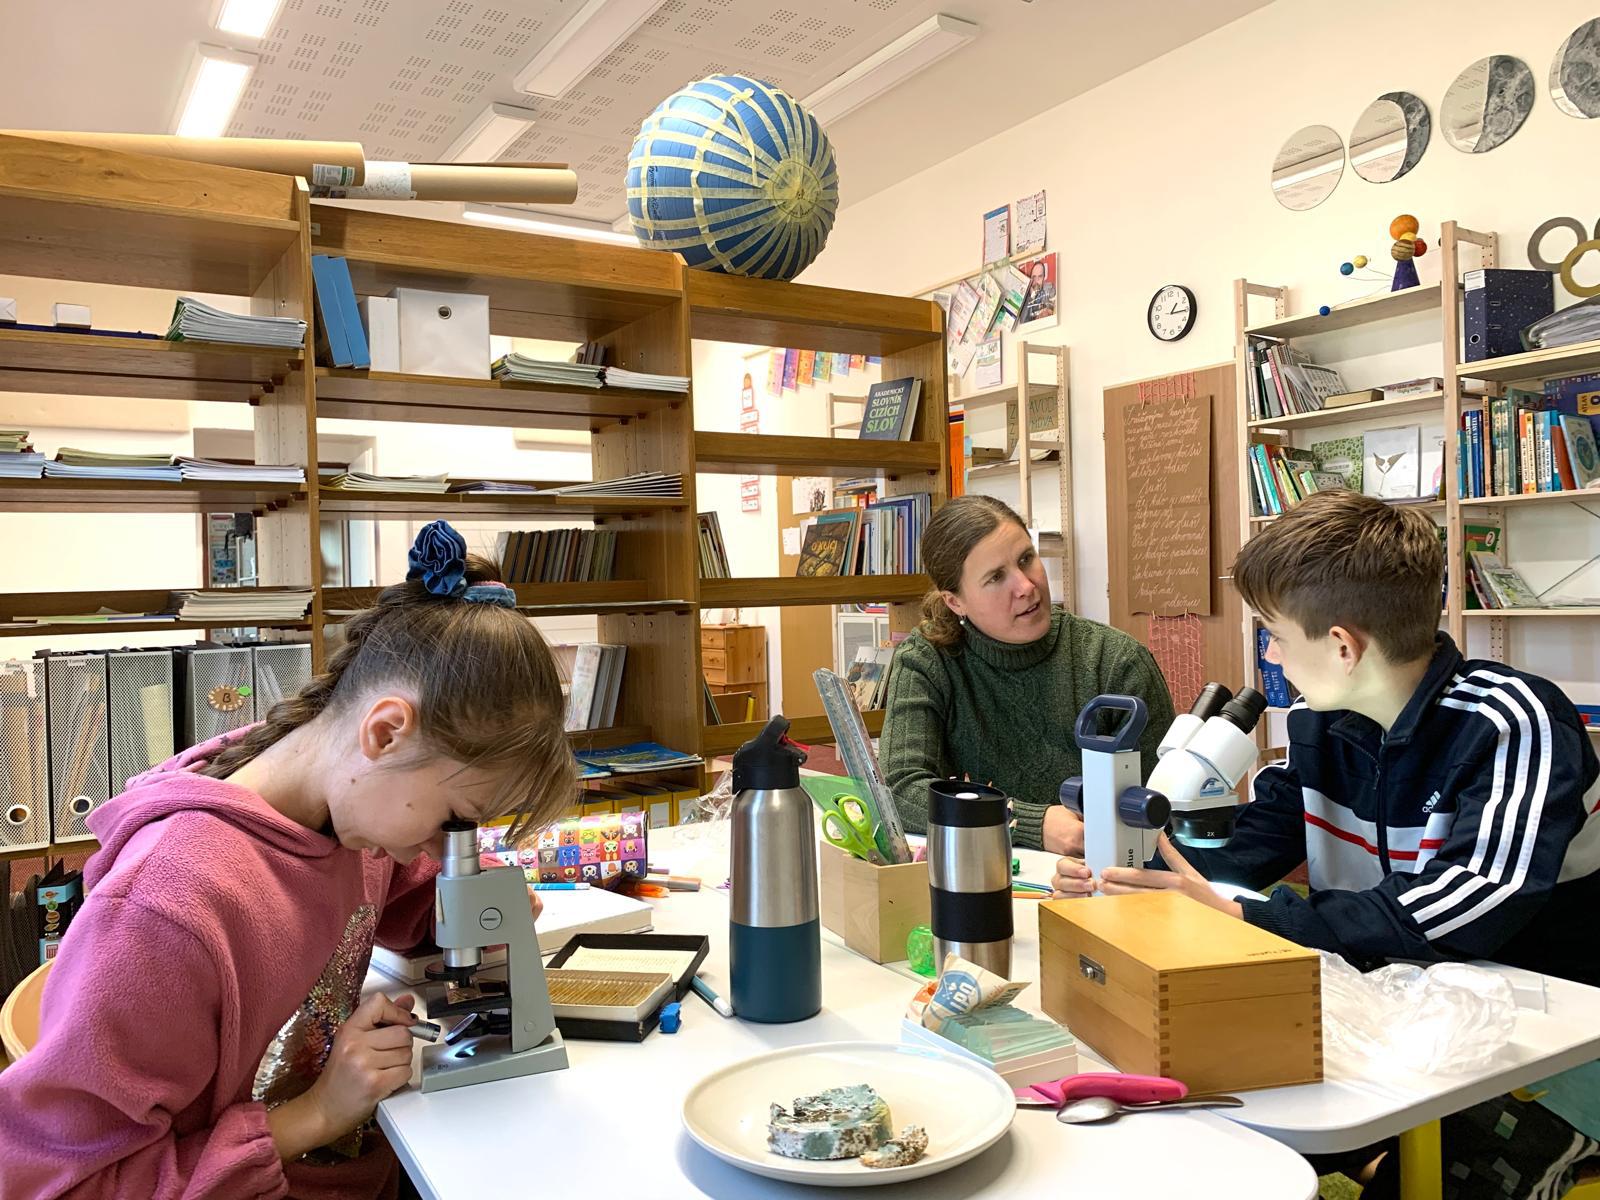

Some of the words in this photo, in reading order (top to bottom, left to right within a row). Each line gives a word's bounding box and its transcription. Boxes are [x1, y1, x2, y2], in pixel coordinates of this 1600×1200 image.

[874, 386, 904, 397] AKADEMICKÝ
[872, 395, 902, 407] SLOVNÍK
[869, 405, 900, 418] CIZÍCH
[866, 417, 897, 432] SLOV
[1487, 533, 1494, 544] 2
